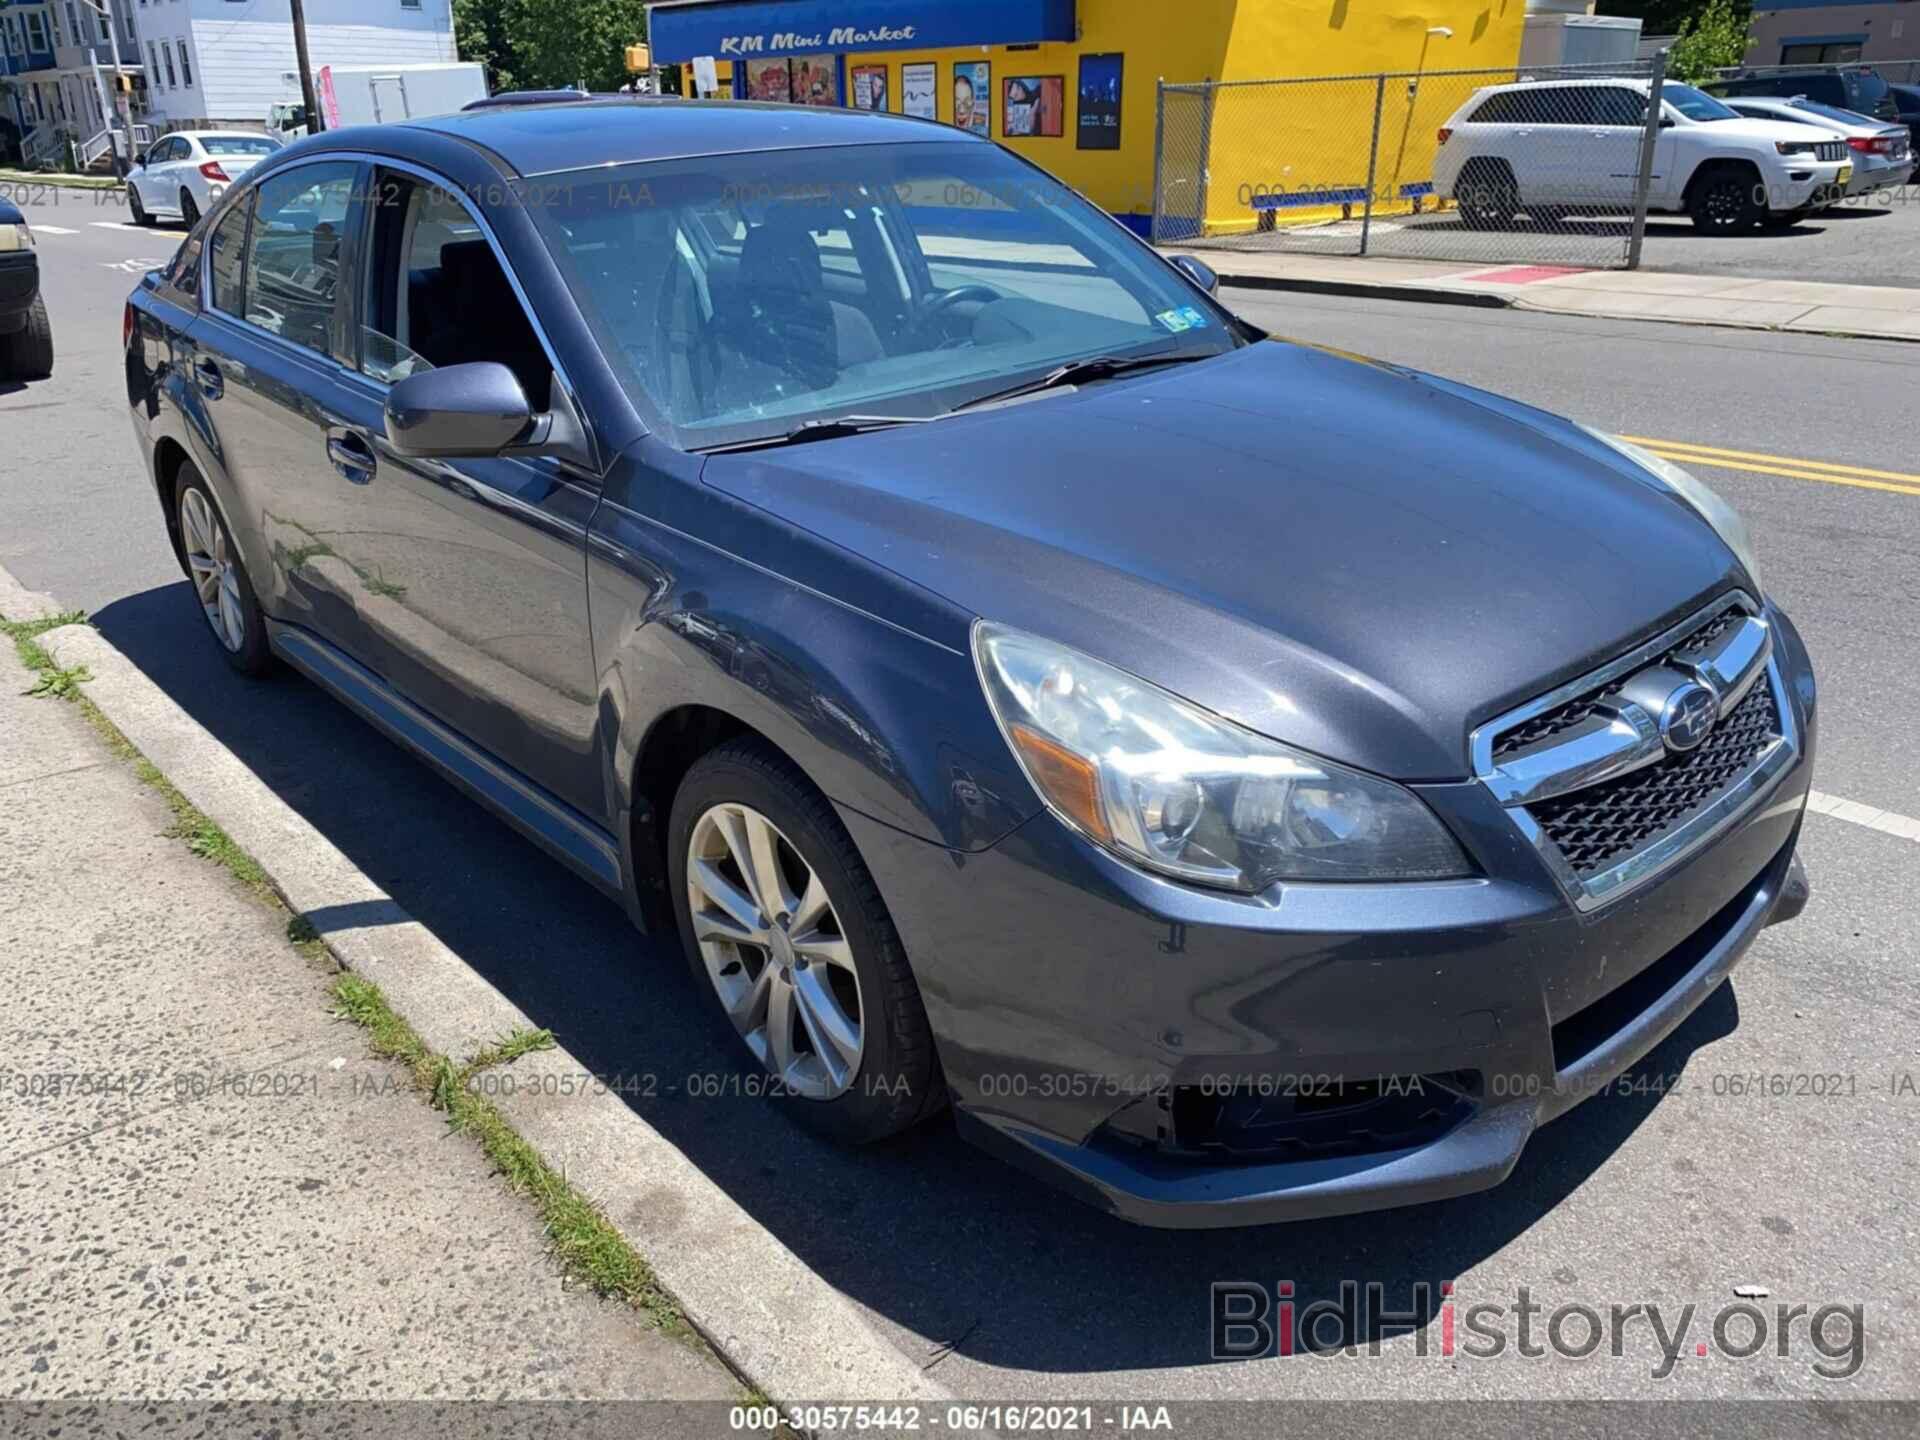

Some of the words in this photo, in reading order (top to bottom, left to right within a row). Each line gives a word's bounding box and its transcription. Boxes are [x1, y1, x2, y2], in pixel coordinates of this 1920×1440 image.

[720, 35, 763, 55] KM
[769, 32, 823, 50] Mini
[827, 25, 916, 46] Market
